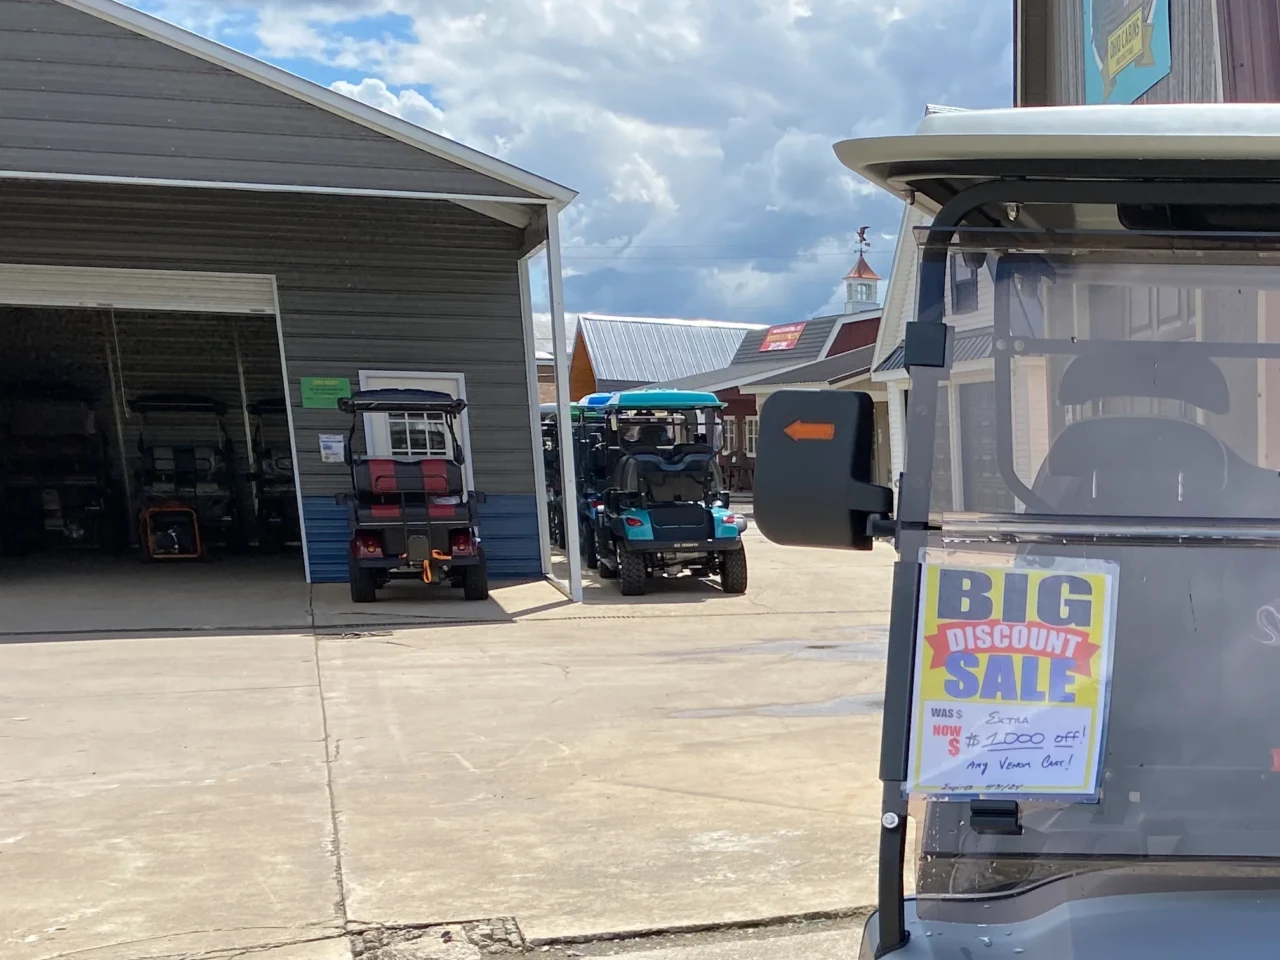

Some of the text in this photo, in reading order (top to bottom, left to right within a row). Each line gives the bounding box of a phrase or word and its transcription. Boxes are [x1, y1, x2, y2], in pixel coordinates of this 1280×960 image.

[937, 569, 1093, 627] BIG
[946, 624, 1081, 657] DISCOUNT
[944, 651, 1076, 703] SALE
[931, 708, 954, 719] WAS
[932, 724, 962, 737] NOW
[948, 737, 960, 757] $
